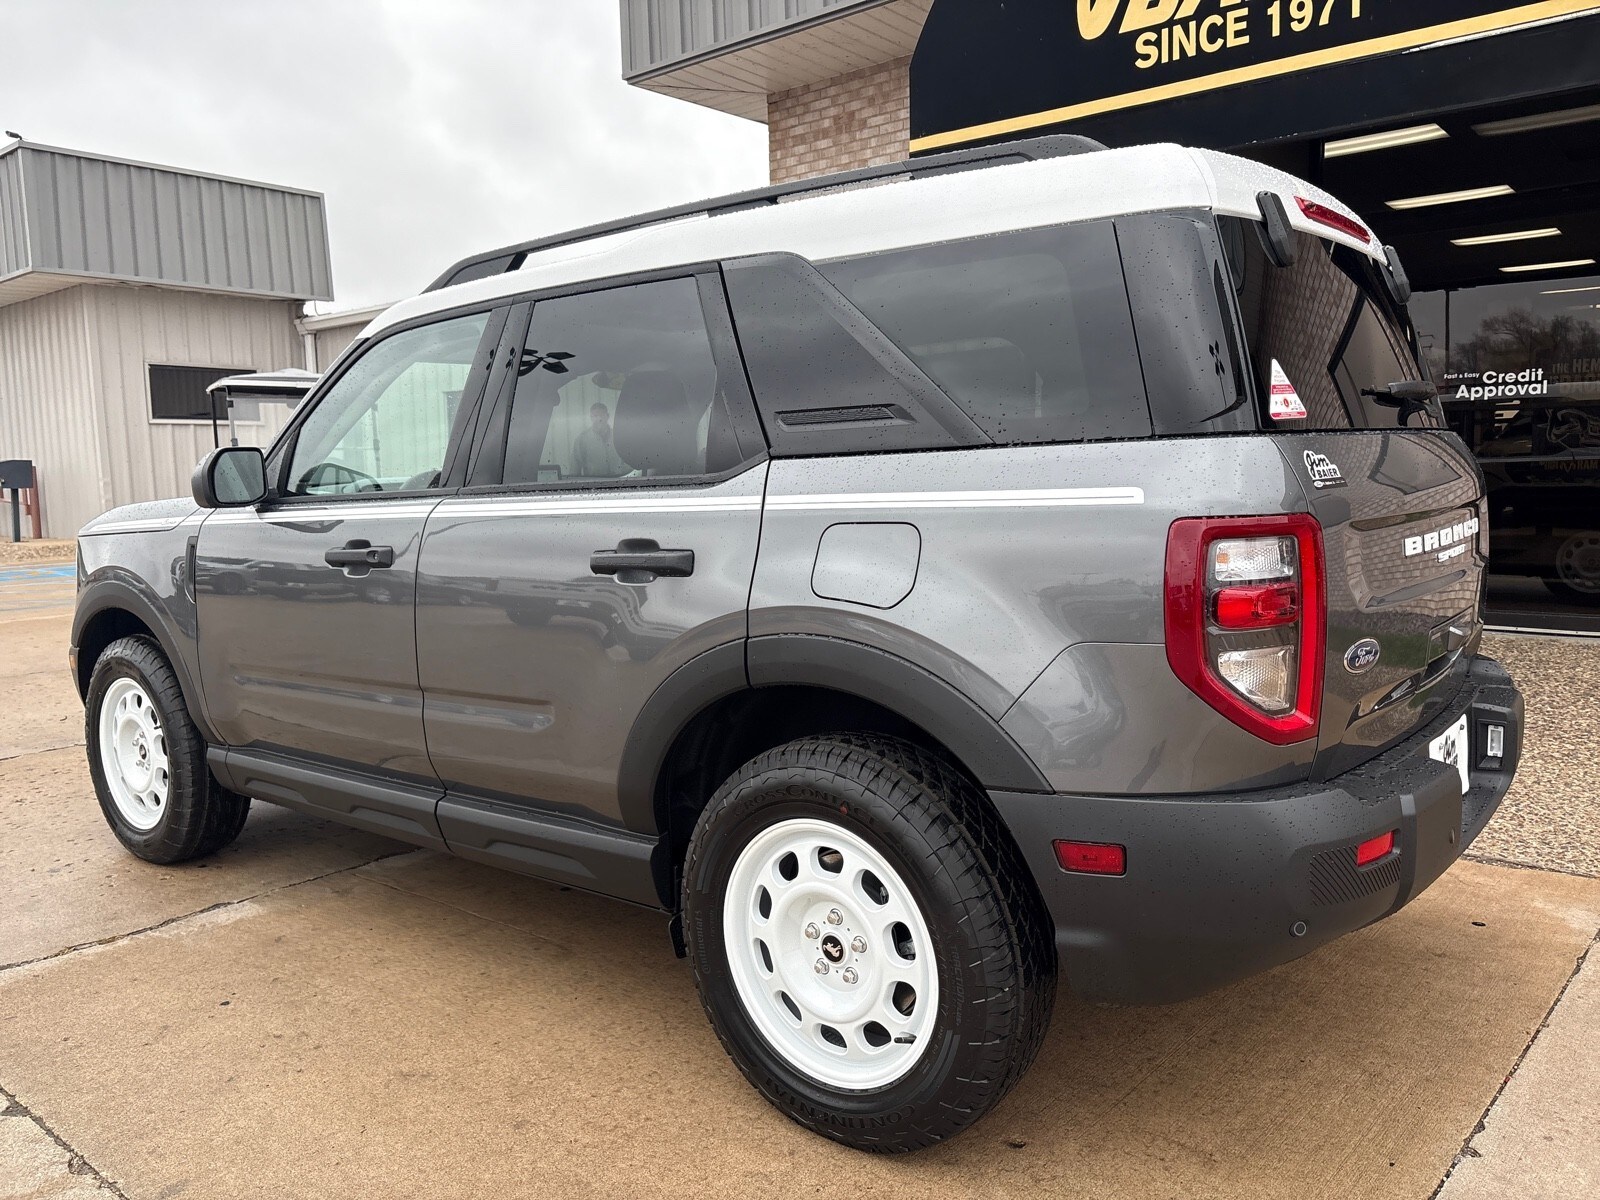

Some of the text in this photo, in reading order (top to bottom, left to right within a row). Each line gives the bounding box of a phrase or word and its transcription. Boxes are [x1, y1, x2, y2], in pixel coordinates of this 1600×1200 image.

[1134, 8, 1250, 69] SINCE
[1482, 368, 1544, 384] Credit
[1455, 380, 1548, 401] Approval
[1316, 468, 1339, 478] BAIER
[1405, 517, 1479, 556] BRONCO
[1438, 544, 1466, 562] SPORT
